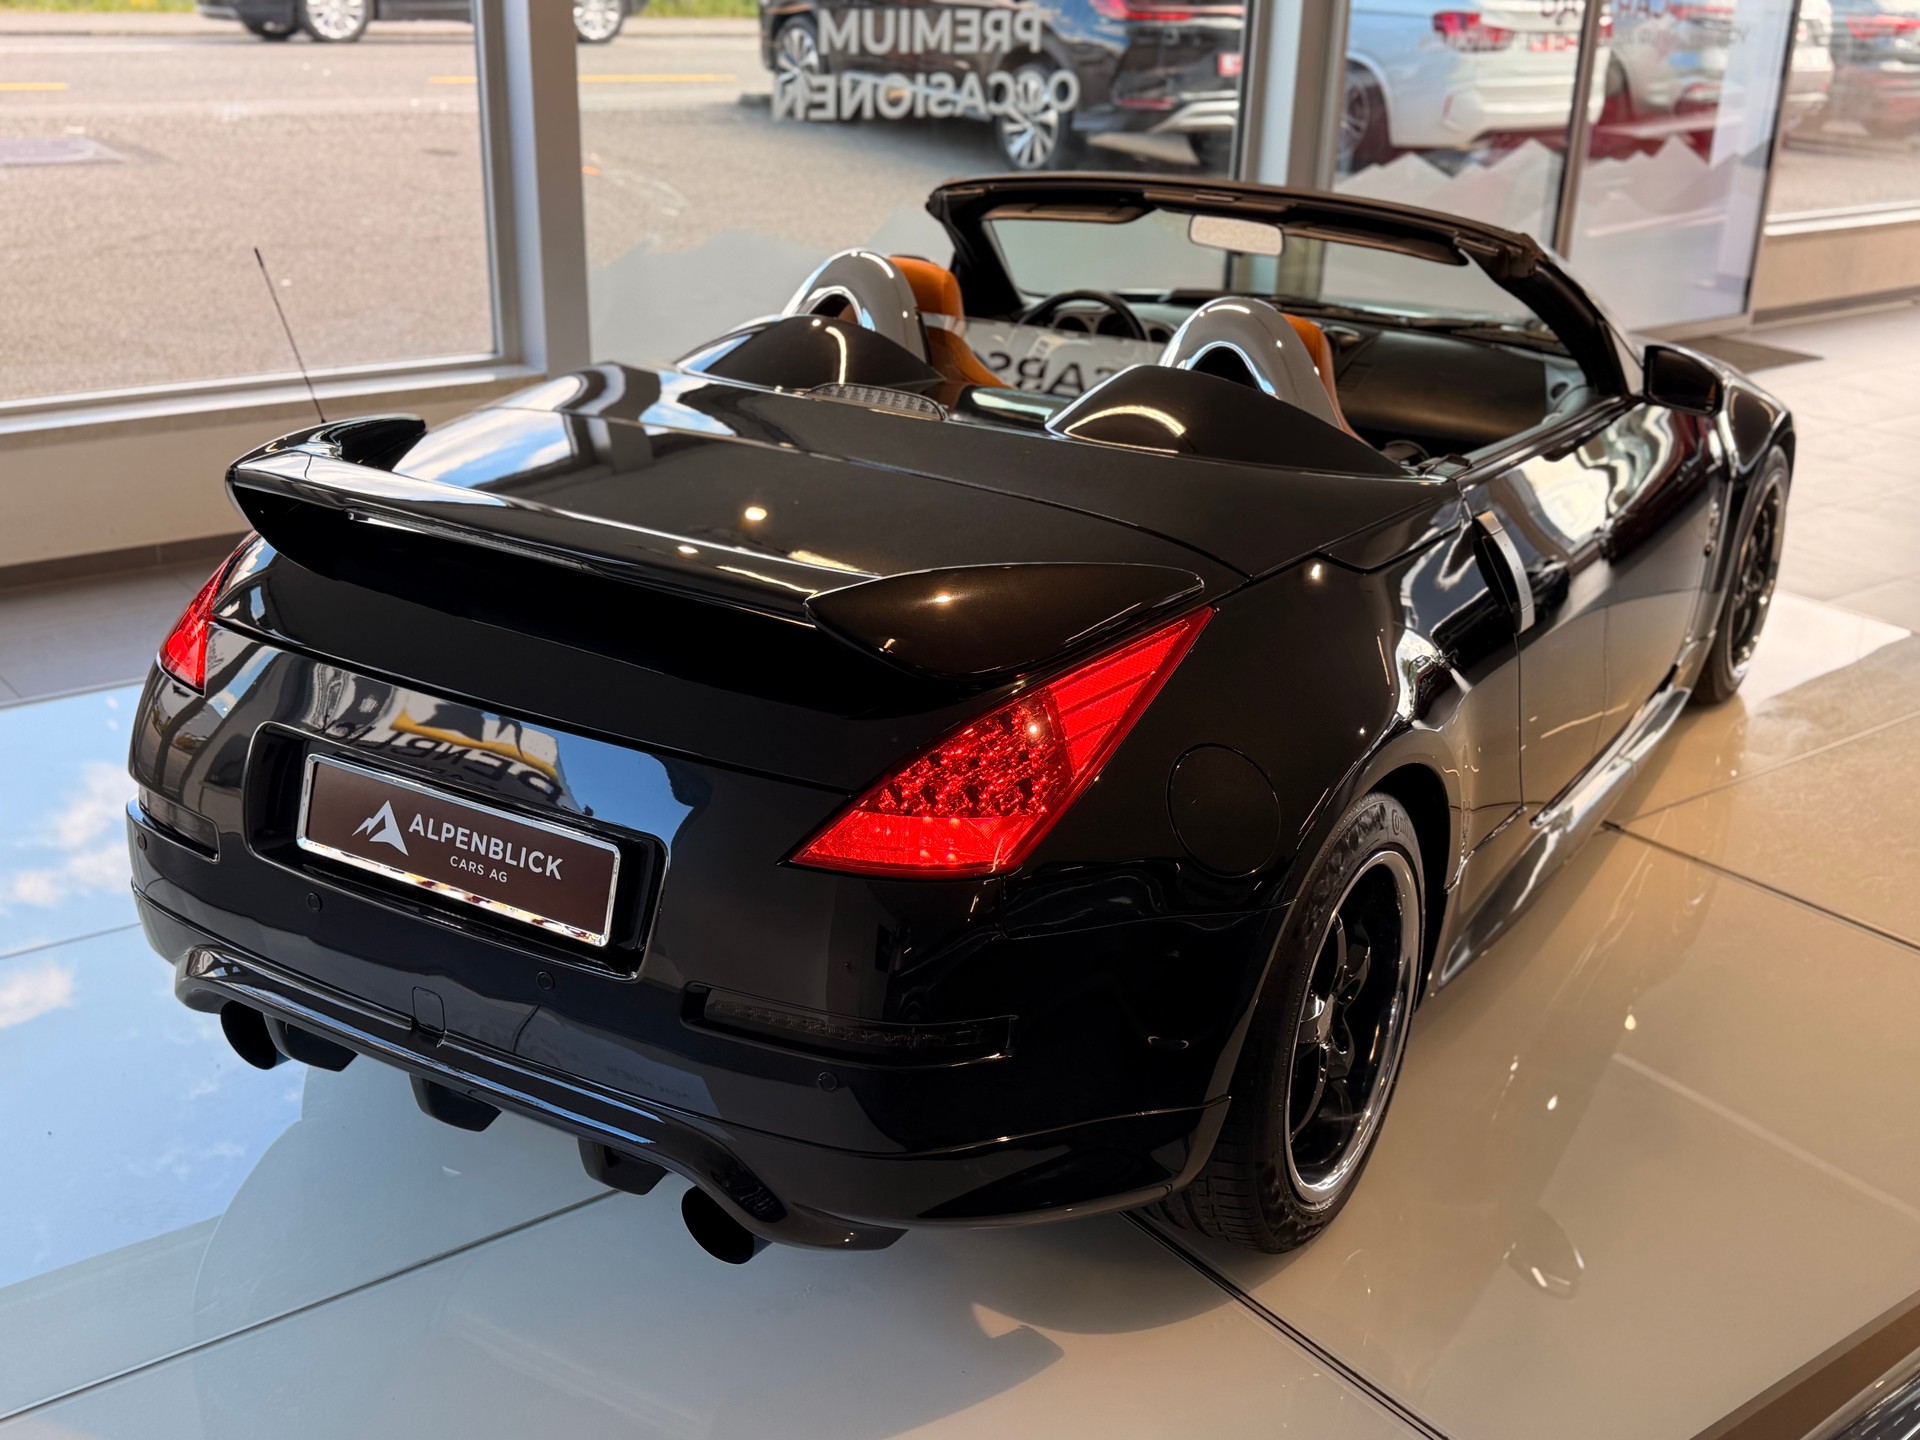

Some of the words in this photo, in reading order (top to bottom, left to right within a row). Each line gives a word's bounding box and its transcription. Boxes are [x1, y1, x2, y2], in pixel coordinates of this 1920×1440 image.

[408, 813, 563, 880] ALPENBLICK
[450, 855, 484, 876] CARS
[489, 868, 508, 883] AG
